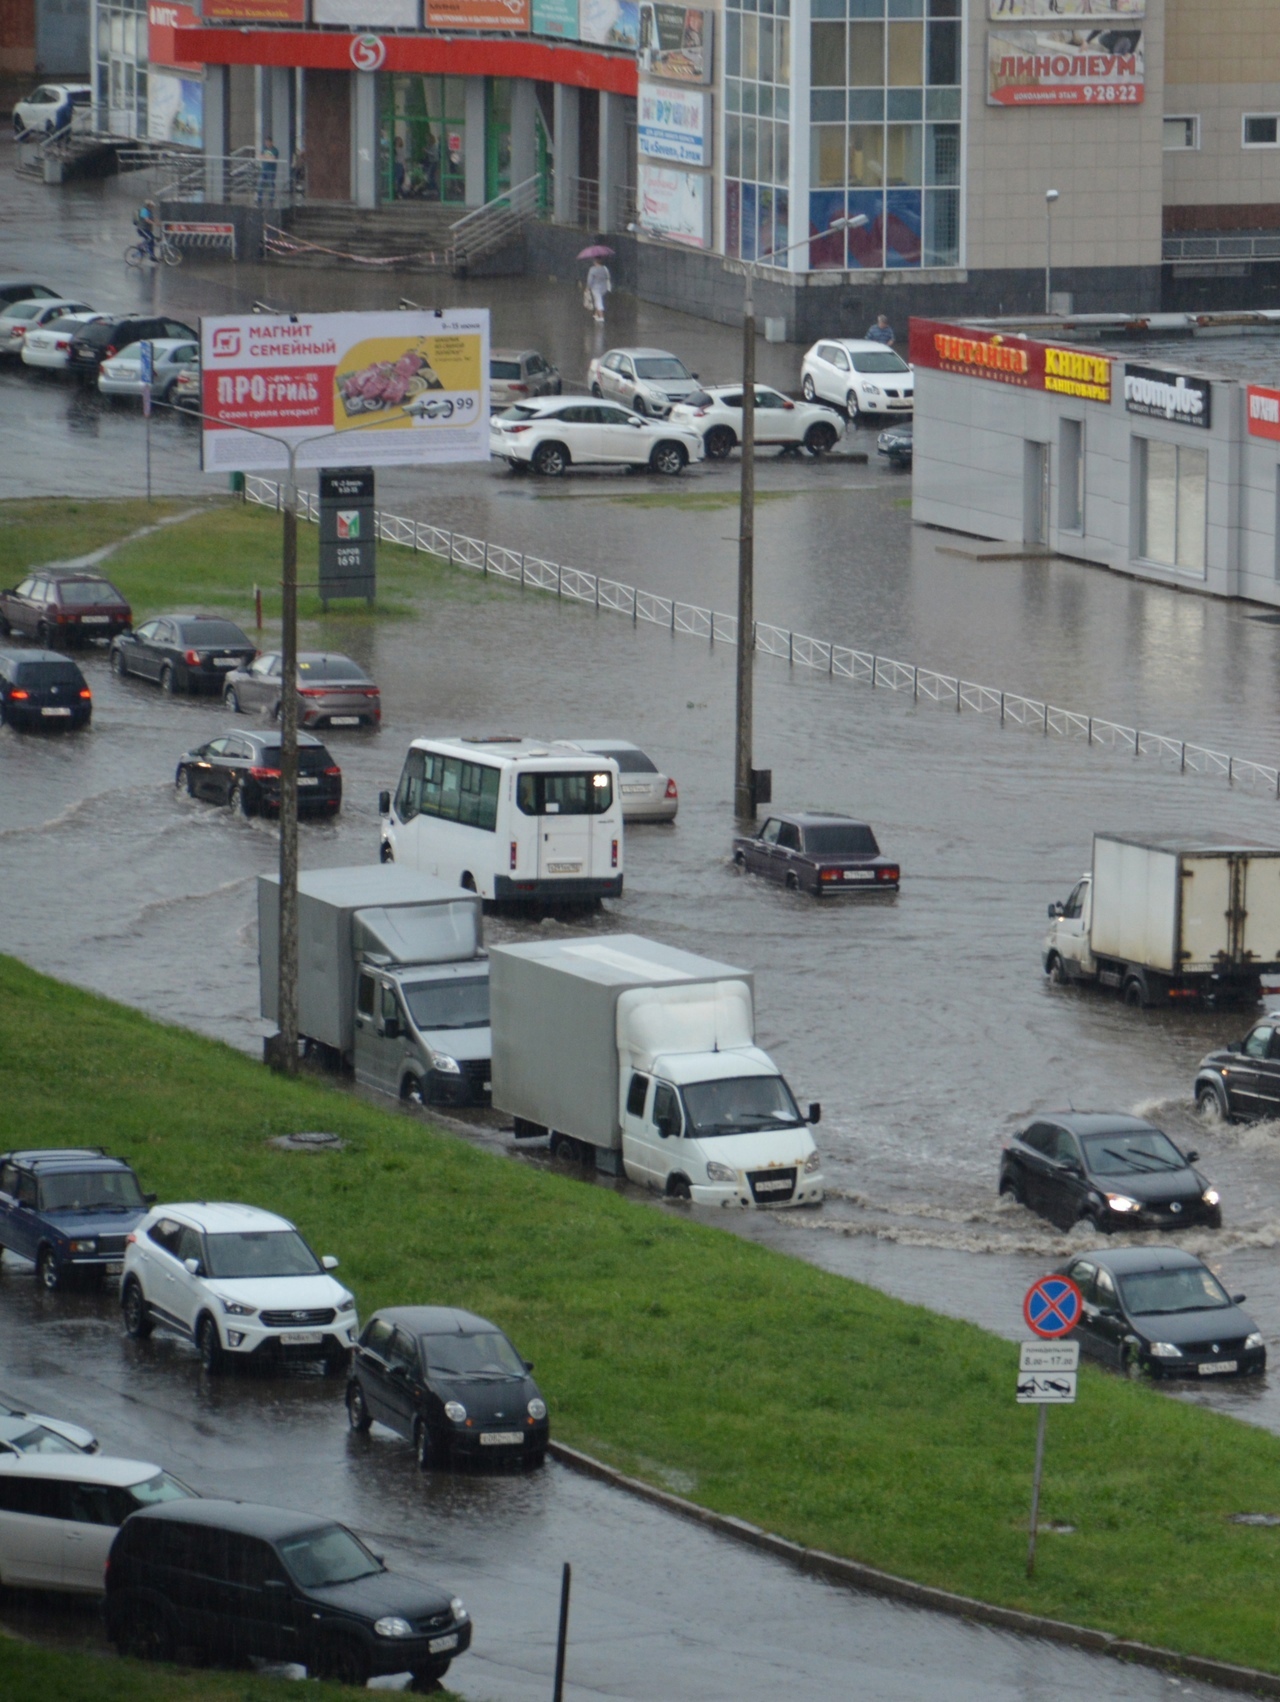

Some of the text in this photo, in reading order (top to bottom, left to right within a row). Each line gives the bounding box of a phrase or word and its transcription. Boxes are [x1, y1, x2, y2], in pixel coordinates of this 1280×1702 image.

[998, 55, 1137, 77] ЛИНОЛЕУМ
[249, 325, 313, 339] МАГНИТ
[249, 338, 337, 357] СЕМЕЙНЫЙ
[1125, 375, 1203, 419] raumplus
[1250, 394, 1279, 424] КУХНИ
